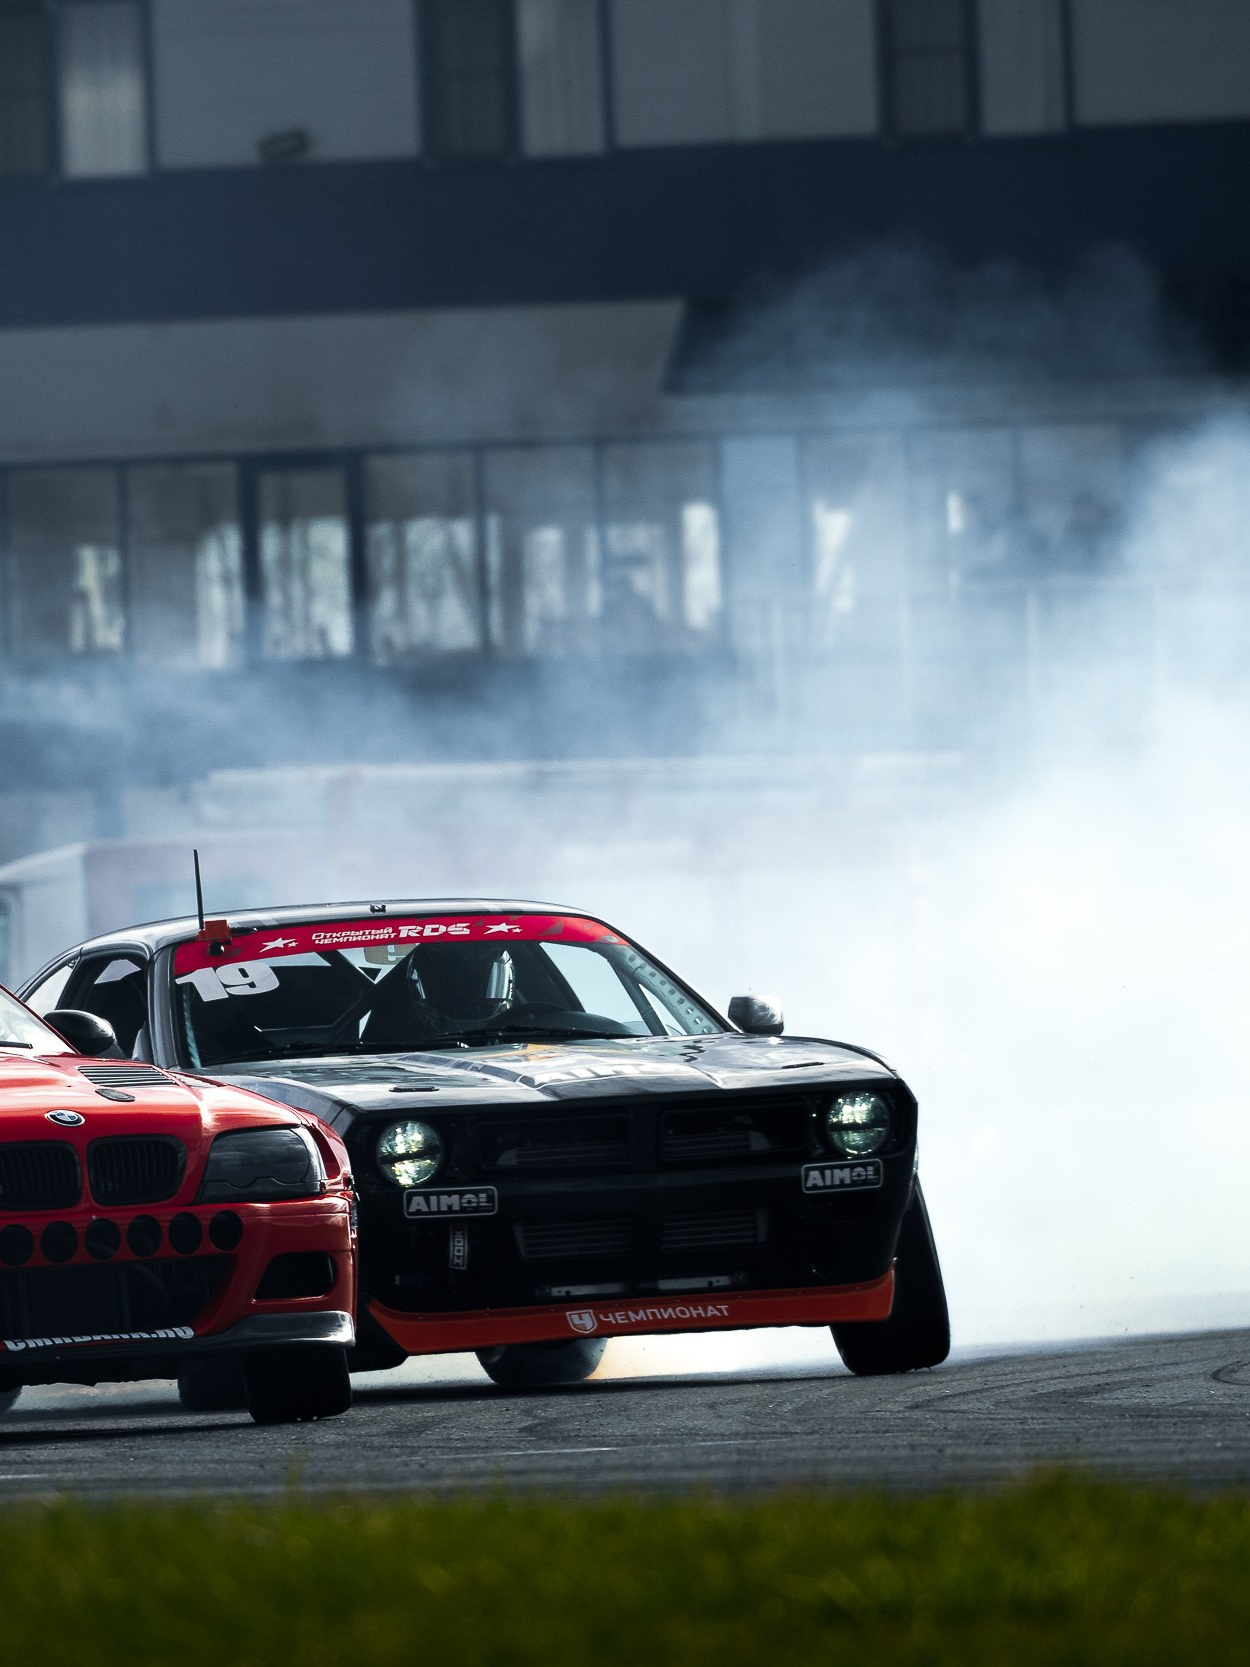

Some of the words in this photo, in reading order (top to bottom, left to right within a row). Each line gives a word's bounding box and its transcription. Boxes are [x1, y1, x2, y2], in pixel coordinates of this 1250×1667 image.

[398, 923, 471, 938] RDS
[175, 962, 280, 1002] 19
[806, 1163, 879, 1189] AIMOL
[408, 1192, 493, 1213] AIMOL
[600, 1305, 729, 1324] ЧЕМПИОНАТ
